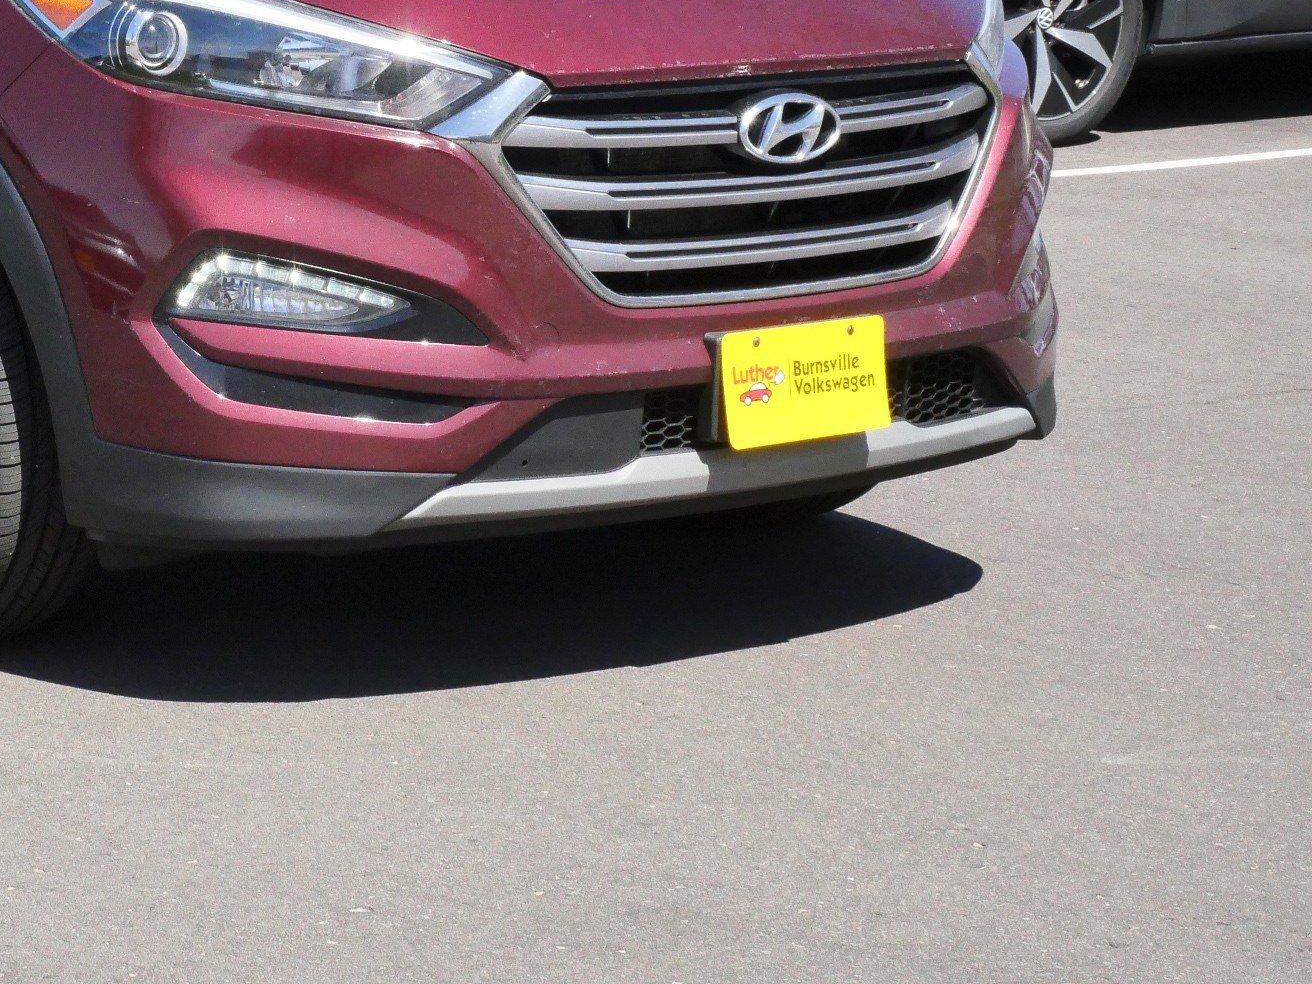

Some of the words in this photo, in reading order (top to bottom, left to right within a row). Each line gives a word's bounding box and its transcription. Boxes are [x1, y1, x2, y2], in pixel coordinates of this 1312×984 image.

[732, 363, 780, 385] Luther
[793, 354, 860, 376] Burnsville
[794, 373, 875, 395] Volkswagen
